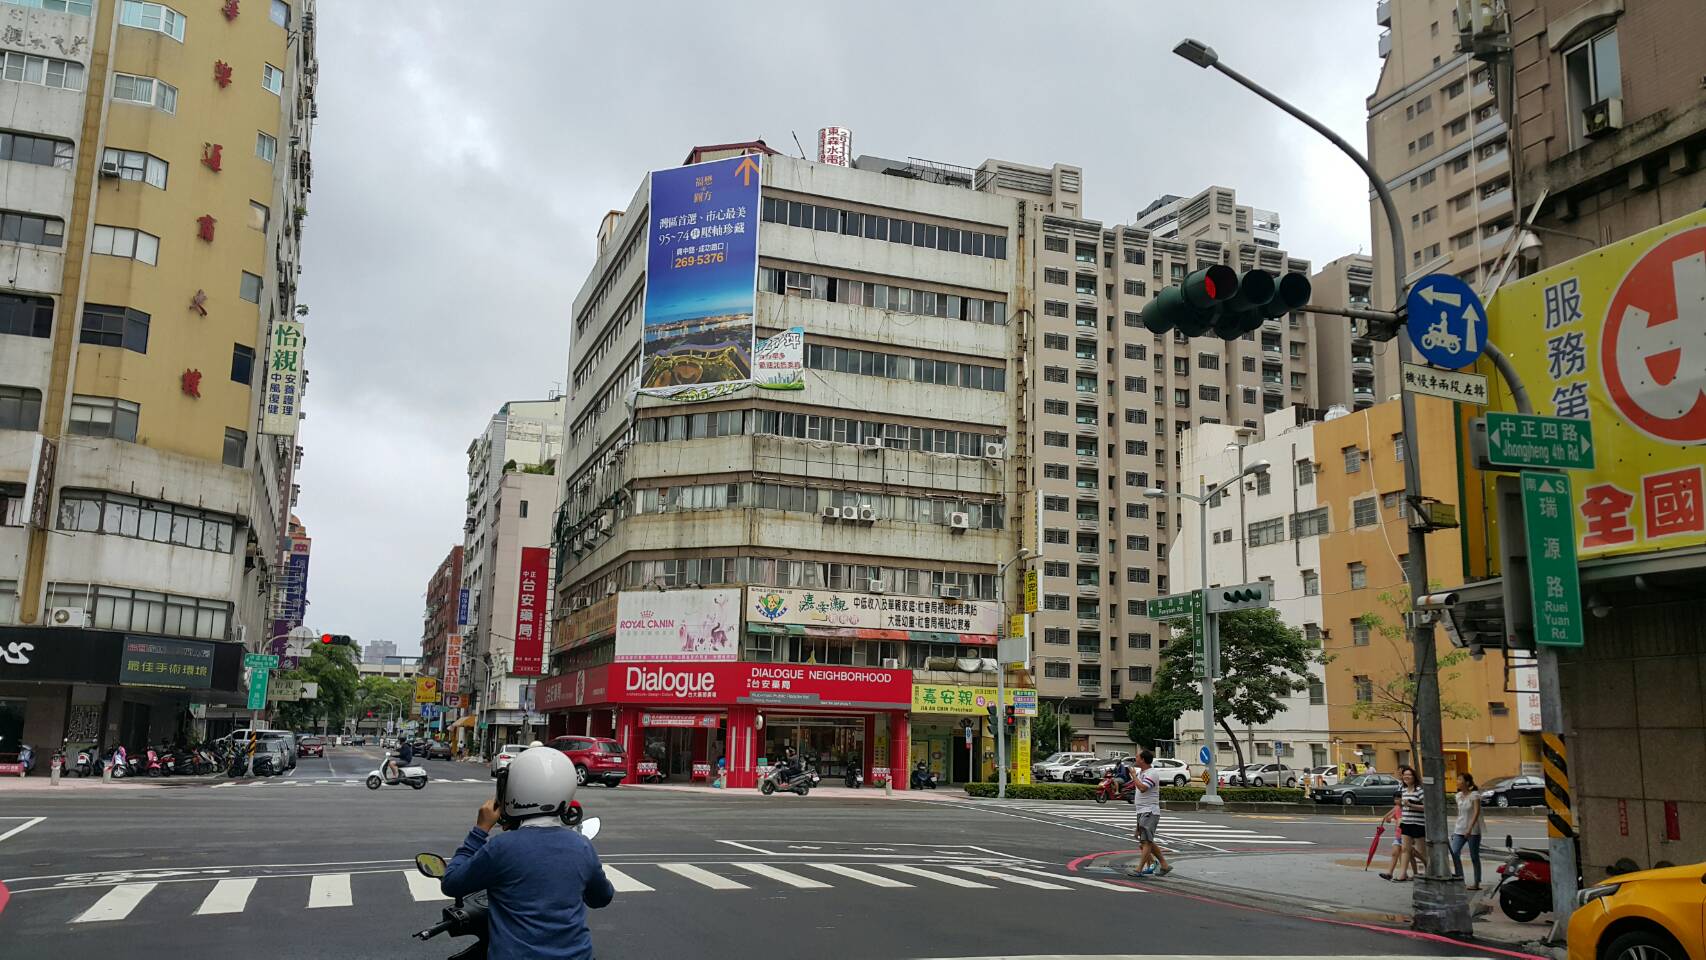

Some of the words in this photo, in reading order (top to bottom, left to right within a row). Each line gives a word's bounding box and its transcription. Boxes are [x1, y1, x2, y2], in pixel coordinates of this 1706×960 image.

[827, 127, 839, 164] 東森水電
[674, 253, 724, 268] 269-5376
[272, 324, 301, 372] 怡親
[267, 373, 282, 415] 中風復健
[282, 374, 297, 416] 安養護理
[1405, 370, 1485, 398] 機慢車兩段左轉
[1501, 418, 1578, 442] 中正四路
[1503, 440, 1549, 463] Jhongjheng
[1552, 445, 1566, 461] 4th
[1581, 467, 1704, 548] 全國
[1540, 497, 1565, 598] 瑞源路
[519, 578, 536, 638] 台安藥局
[1545, 601, 1568, 613] Ruei
[620, 620, 645, 629] ROYAL
[647, 619, 674, 628] CANIN
[1545, 615, 1570, 626] Yuan
[1552, 627, 1569, 639] Rd.
[127, 660, 208, 677] 最佳手術環境
[751, 667, 804, 680] DIALOGUE
[808, 670, 892, 683] NEIGHBORHOOD
[626, 666, 715, 697] Dialogue
[751, 679, 791, 690] 台安藥局
[922, 687, 973, 706] 嘉安親
